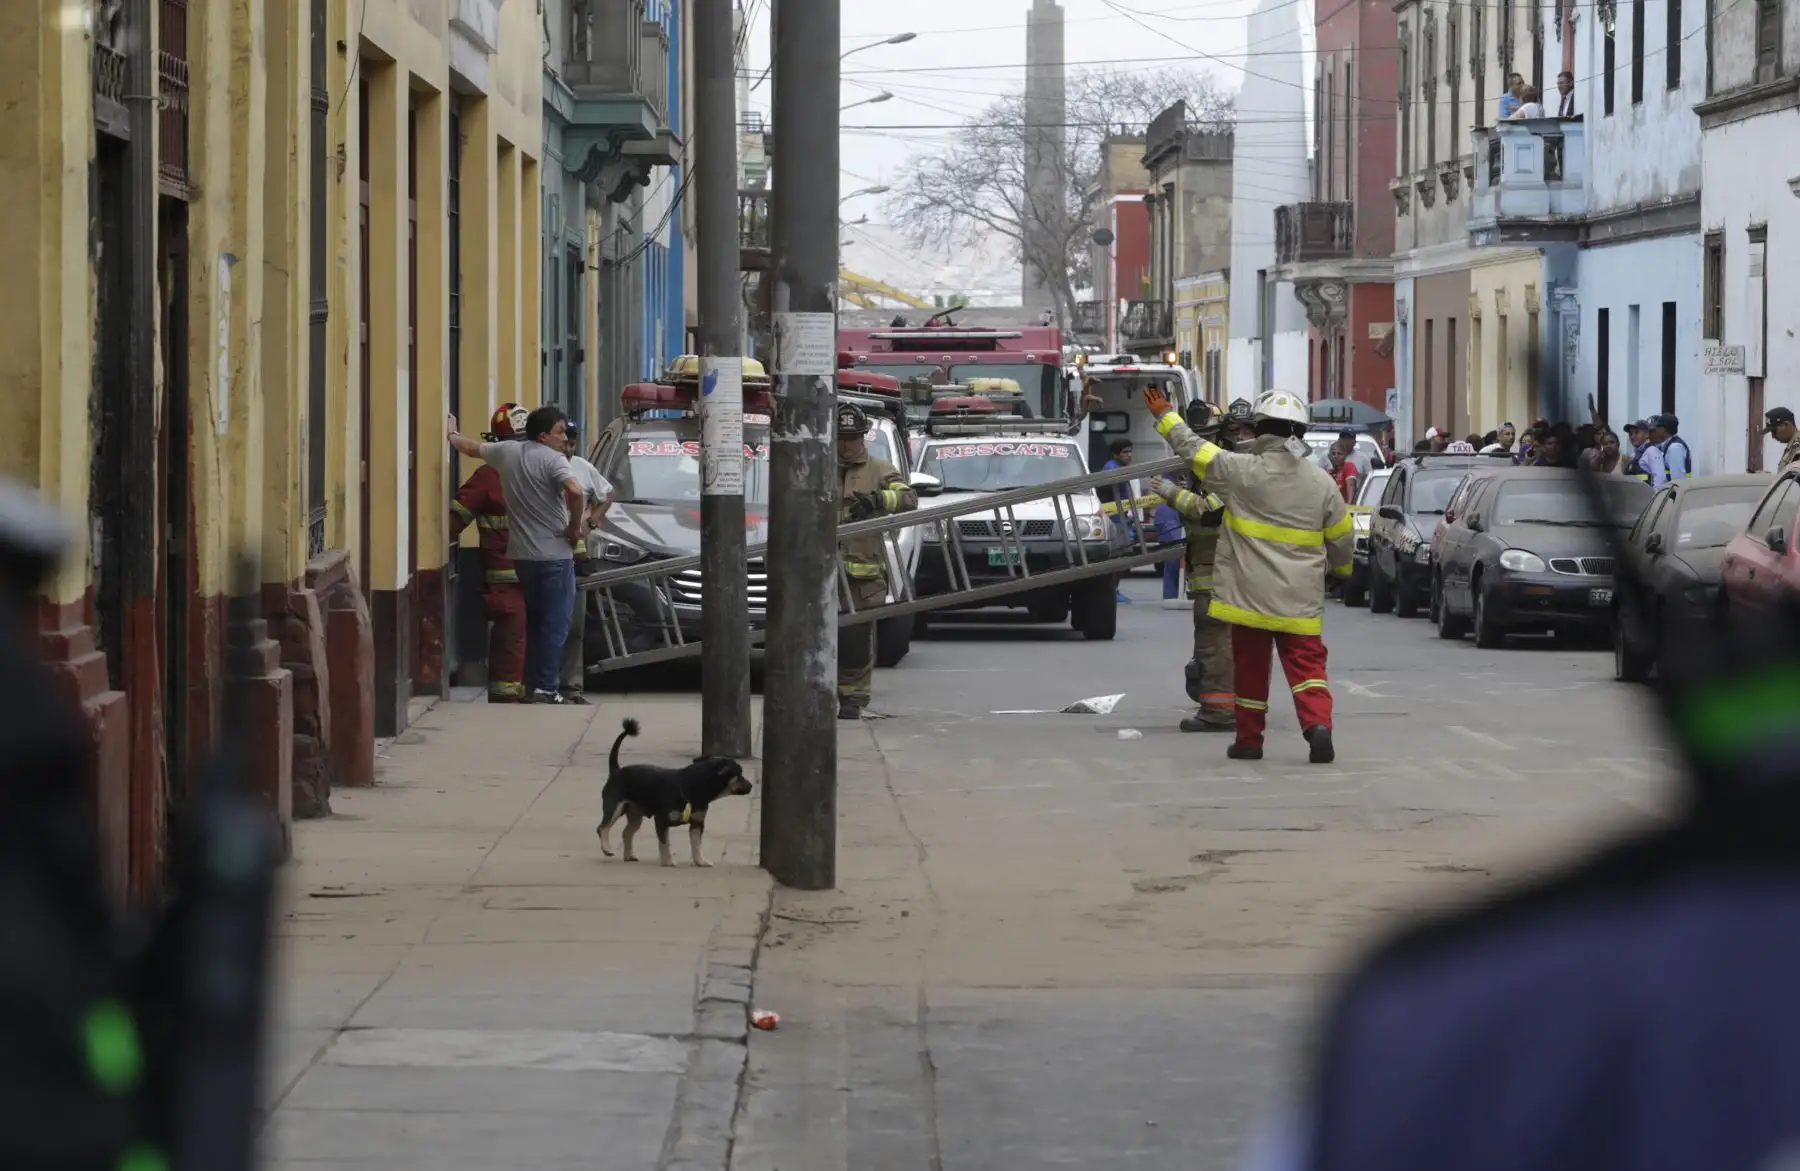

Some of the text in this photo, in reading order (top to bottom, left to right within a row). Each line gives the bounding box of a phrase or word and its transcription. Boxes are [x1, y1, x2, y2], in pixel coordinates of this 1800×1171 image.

[840, 414, 854, 425] 36
[936, 443, 1069, 460] RESCATE
[1453, 445, 1471, 453] TAXI
